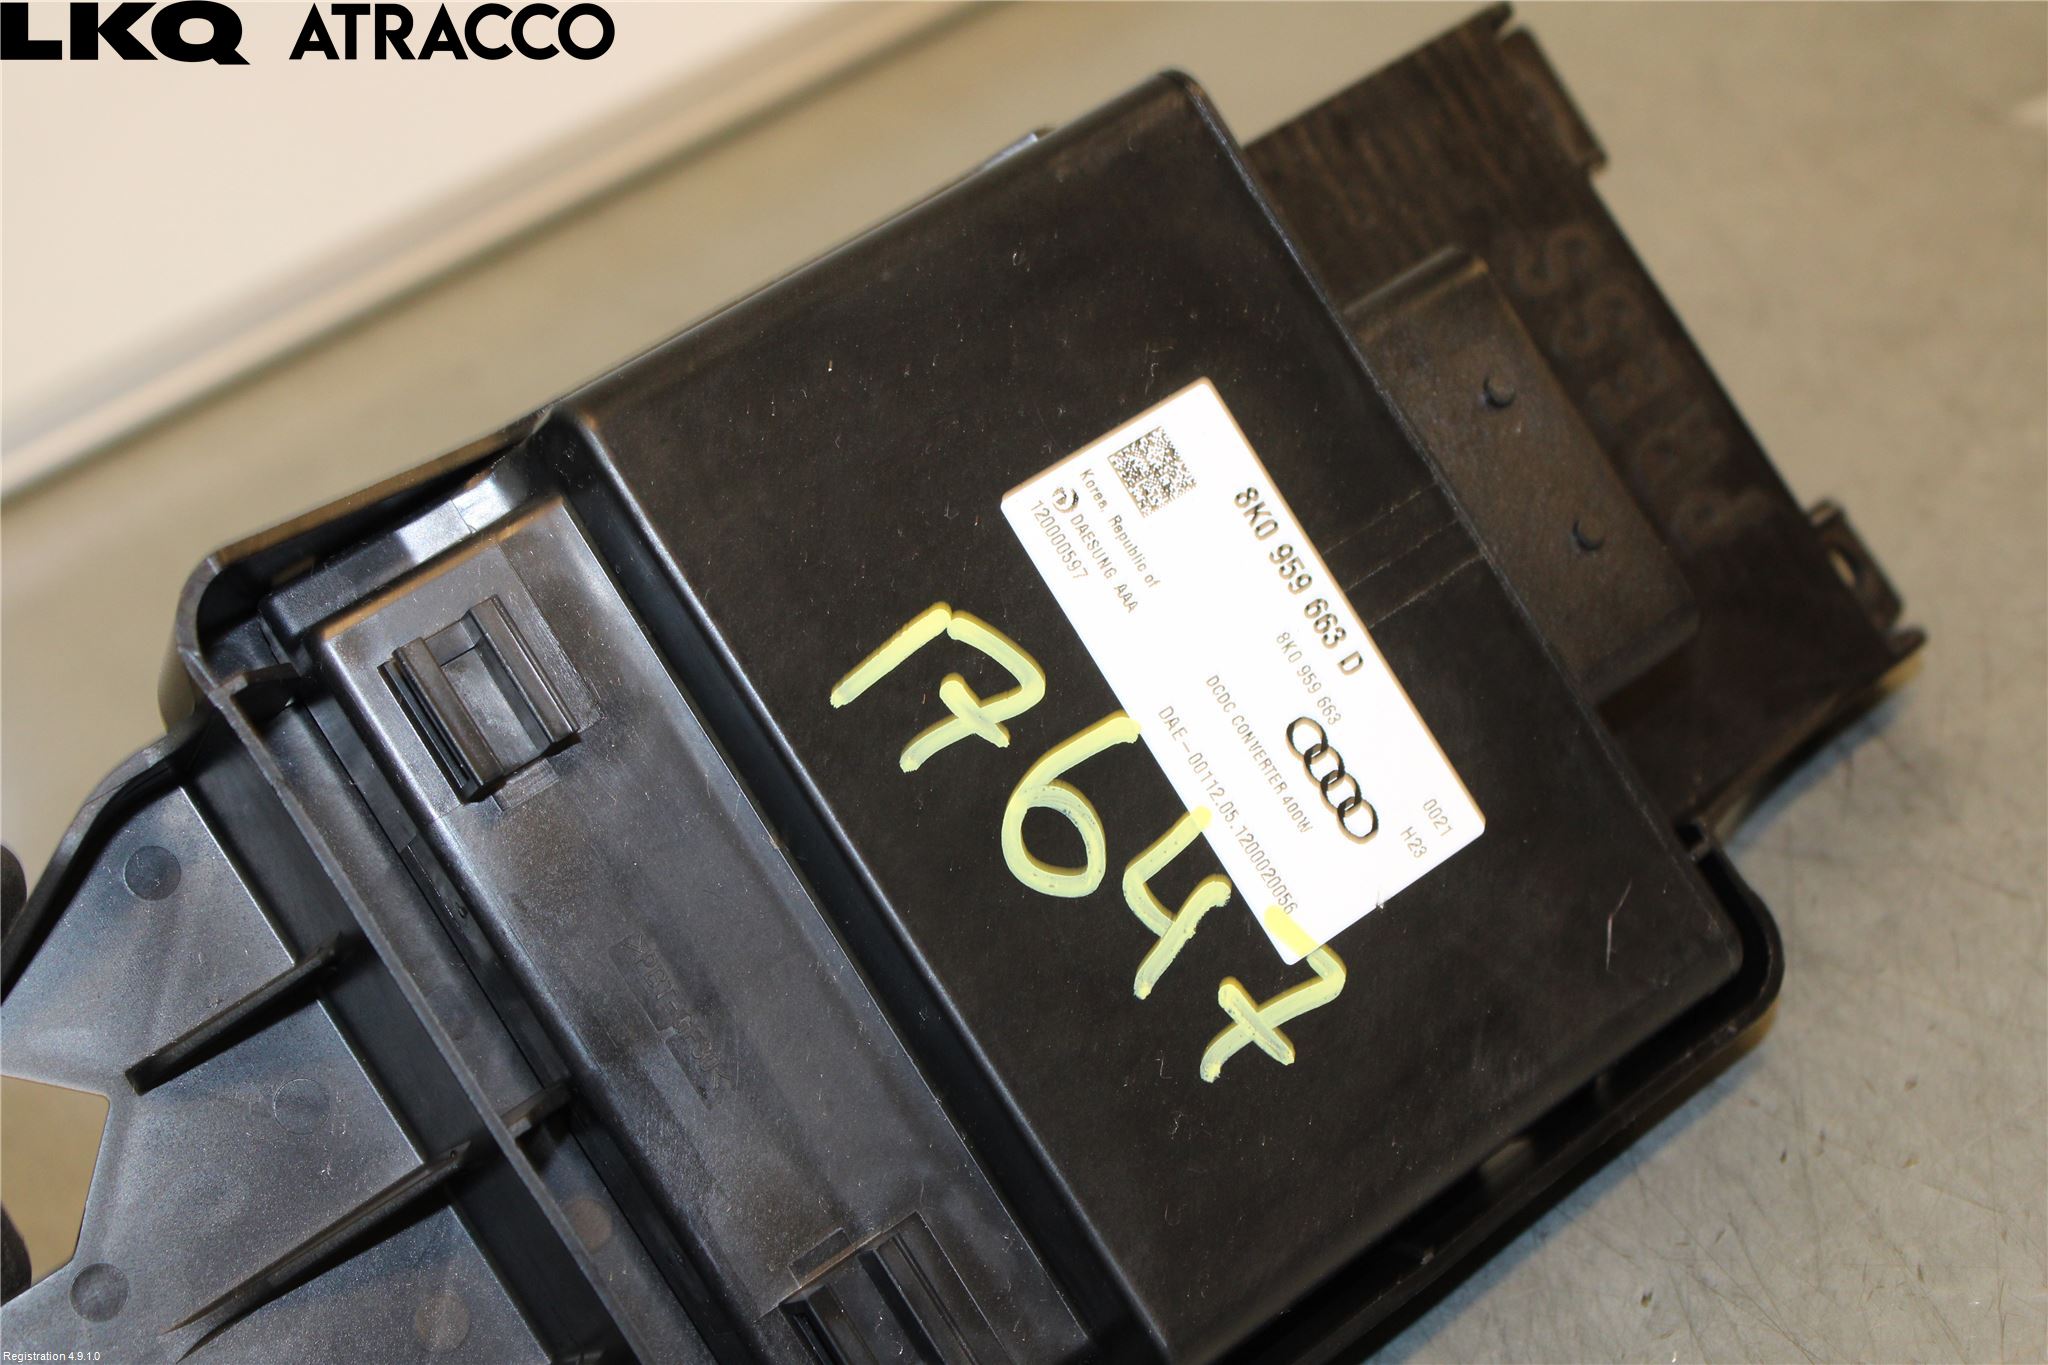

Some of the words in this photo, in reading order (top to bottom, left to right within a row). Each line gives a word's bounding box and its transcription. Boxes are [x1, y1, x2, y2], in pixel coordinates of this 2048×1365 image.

[1031, 500, 1088, 578] 120000597
[1070, 514, 1117, 579] DAESUNG
[1114, 584, 1138, 613] AAA
[1108, 514, 1146, 571] Republic
[1143, 572, 1163, 590] of
[1234, 487, 1279, 540] 8K0
[1269, 544, 1312, 594] 959
[1304, 598, 1347, 648] 663
[1337, 651, 1364, 674] D
[1277, 632, 1302, 663] 8K0
[1297, 665, 1321, 693] 959
[1317, 697, 1341, 724] 663
[1206, 674, 1237, 713] DCDC
[1232, 715, 1287, 794] CONVERTER
[1281, 795, 1313, 833] 400W
[1401, 826, 1427, 857] H23
[1422, 798, 1454, 836] 0021
